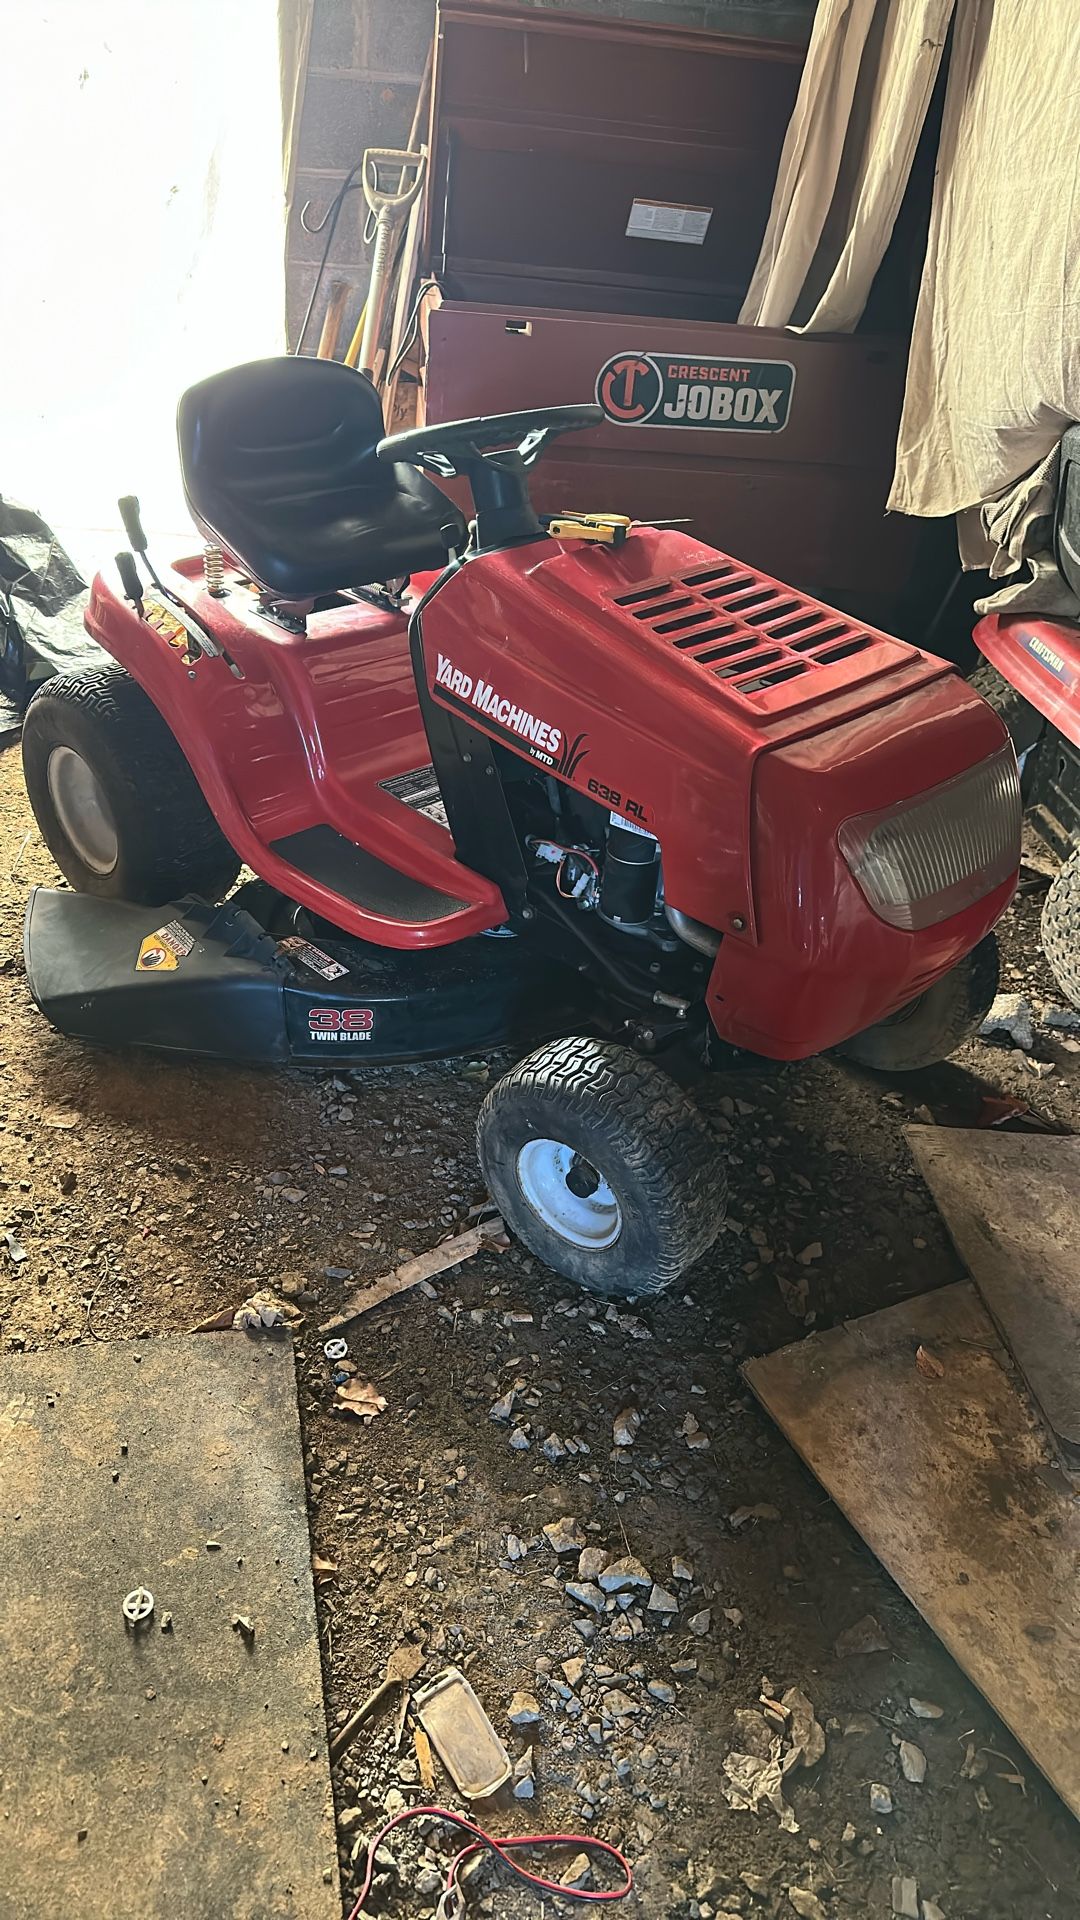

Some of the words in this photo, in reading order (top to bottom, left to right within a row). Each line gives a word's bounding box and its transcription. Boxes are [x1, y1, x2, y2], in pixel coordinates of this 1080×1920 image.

[668, 364, 750, 382] CRESCENT
[664, 384, 783, 424] JOBOX
[1029, 636, 1065, 672] CRAFTSMAN
[435, 653, 473, 699] YARD
[471, 679, 562, 753] MACHINES
[529, 746, 536, 757] by
[535, 750, 554, 766] MTD
[587, 778, 622, 807] 638
[625, 799, 648, 822] RL
[308, 1008, 374, 1031] 38
[310, 1031, 338, 1041] TWIN
[340, 1031, 372, 1041] BLADE
